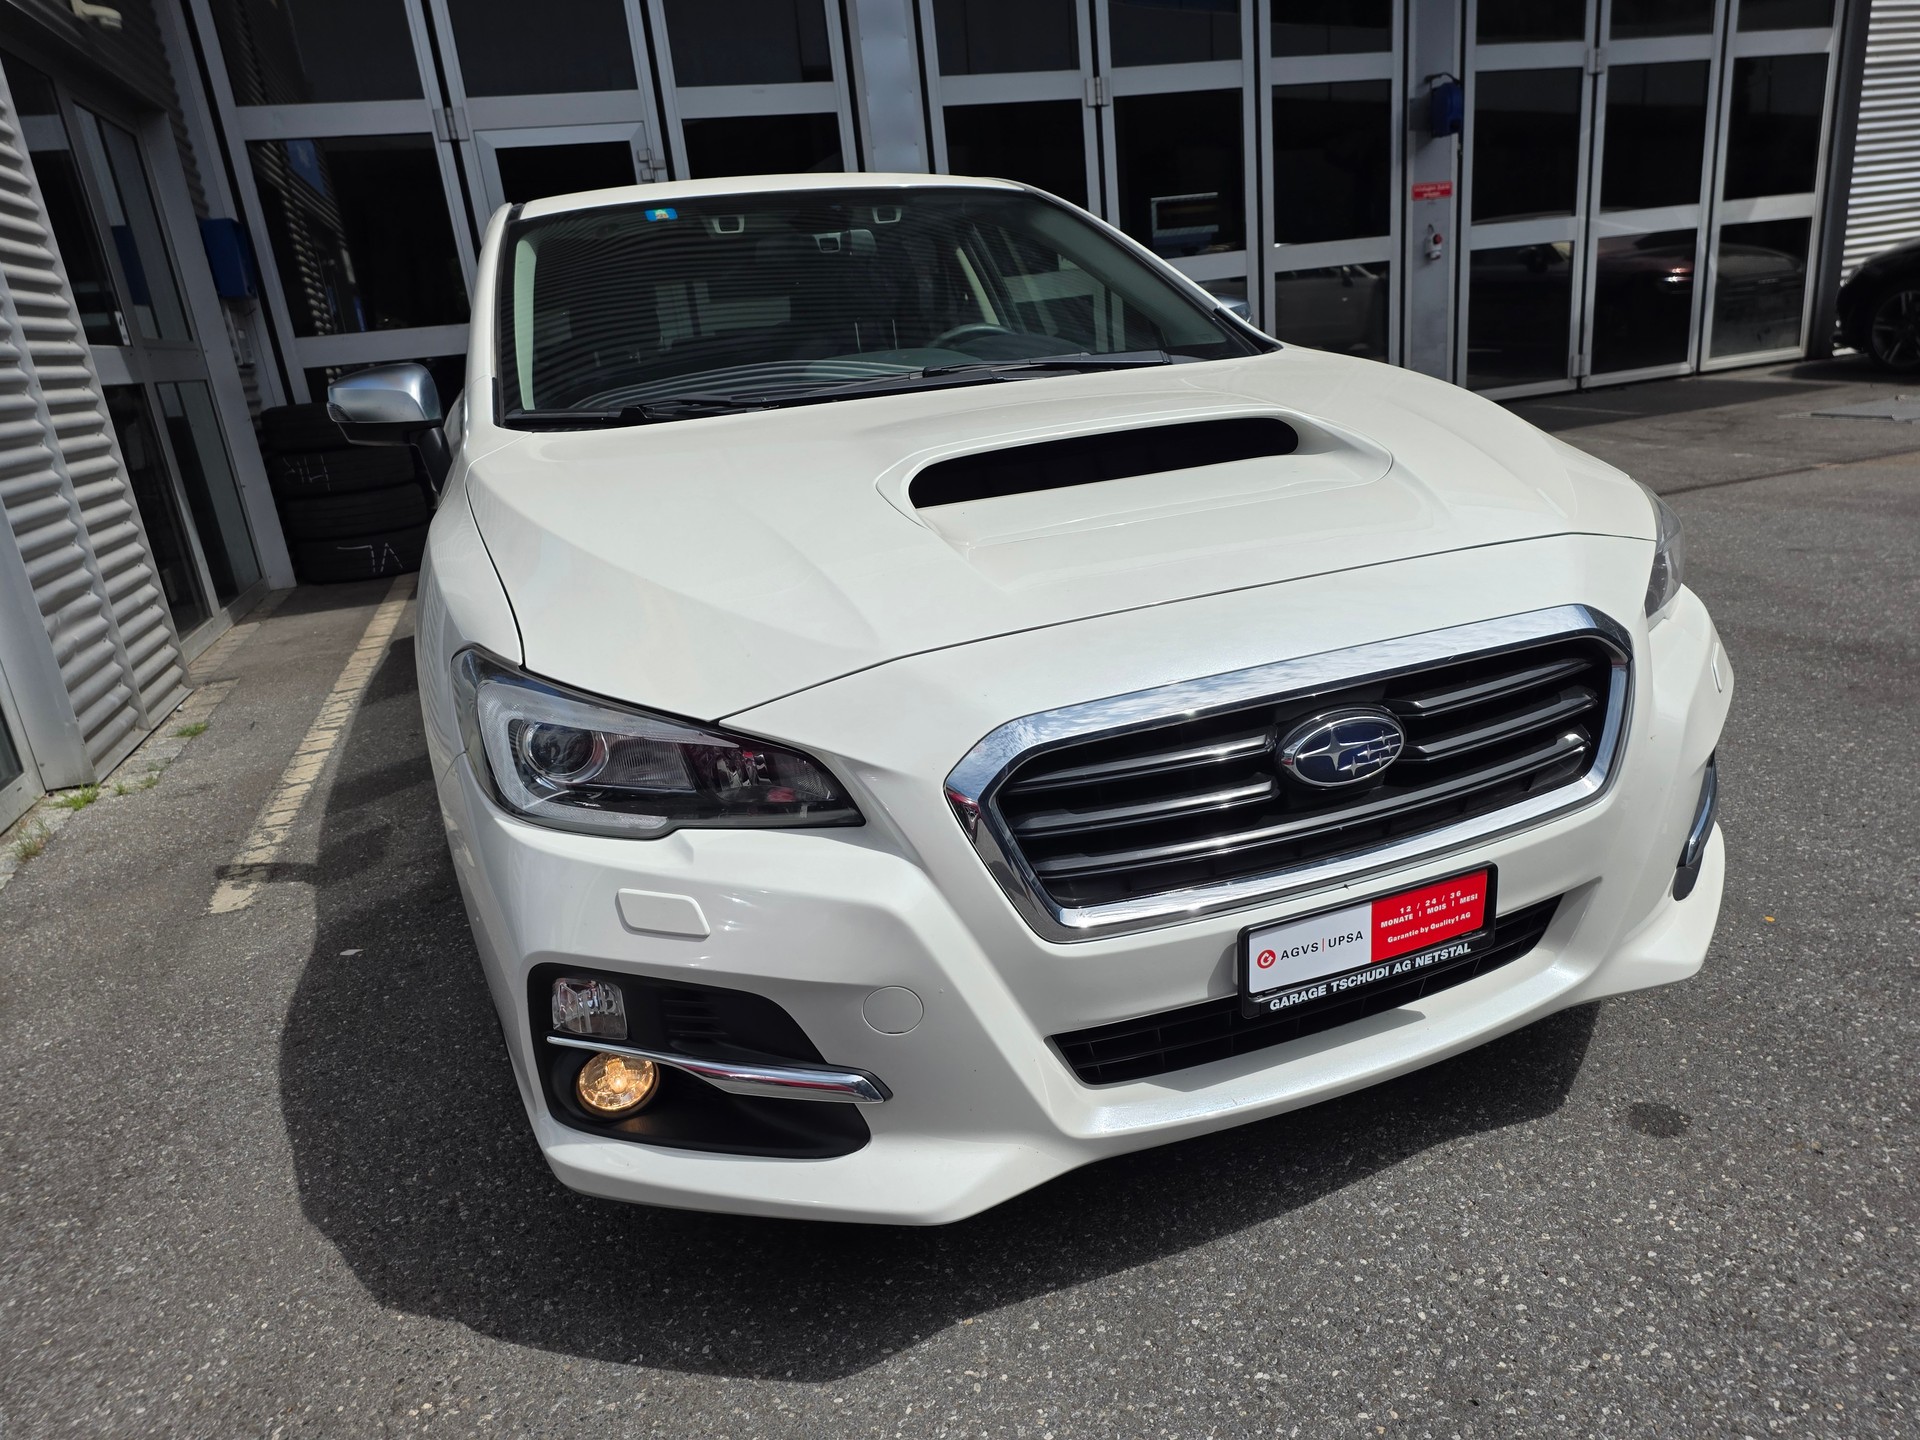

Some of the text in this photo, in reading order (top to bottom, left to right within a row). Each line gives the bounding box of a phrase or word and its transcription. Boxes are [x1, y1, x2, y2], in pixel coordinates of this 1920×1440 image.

[1380, 913, 1414, 929] MONATE
[1426, 903, 1447, 915] MOIS
[1459, 893, 1478, 905] MESI
[1400, 905, 1412, 914] 12
[1425, 897, 1437, 907] 24
[1449, 890, 1462, 899] 36
[1387, 911, 1471, 943] Garantie by Quality1 AG
[1280, 930, 1363, 961] AGVS UPSA
[1269, 942, 1472, 1012] GARAGE TSCHUDI AG NETSTAL
